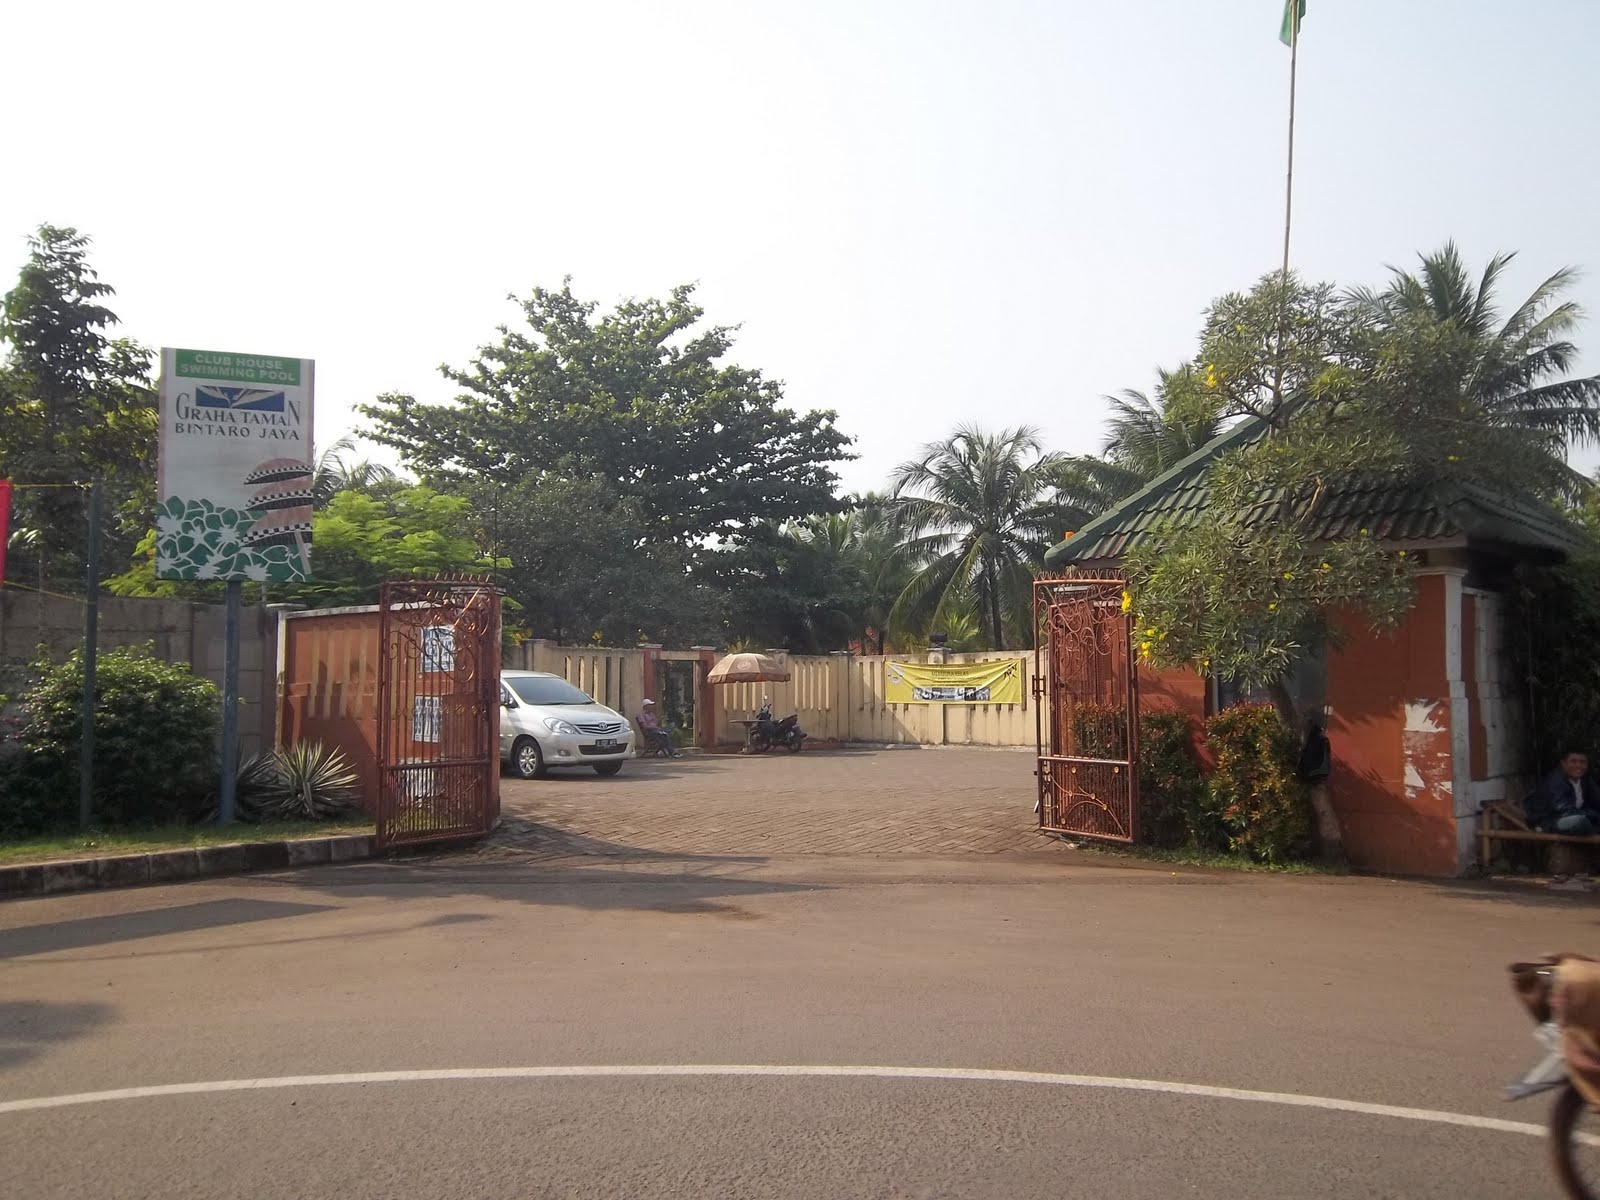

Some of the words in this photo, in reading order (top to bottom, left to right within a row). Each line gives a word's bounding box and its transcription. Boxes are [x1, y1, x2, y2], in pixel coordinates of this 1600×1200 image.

[195, 354, 233, 366] CLUB
[236, 358, 283, 369] HOUSE
[181, 364, 255, 378] SWIMMING
[259, 369, 296, 381] POOL
[176, 392, 236, 423] GRAHA
[240, 400, 301, 427] TAMAN
[175, 423, 250, 437] BINTARO
[259, 428, 300, 440] JAYA
